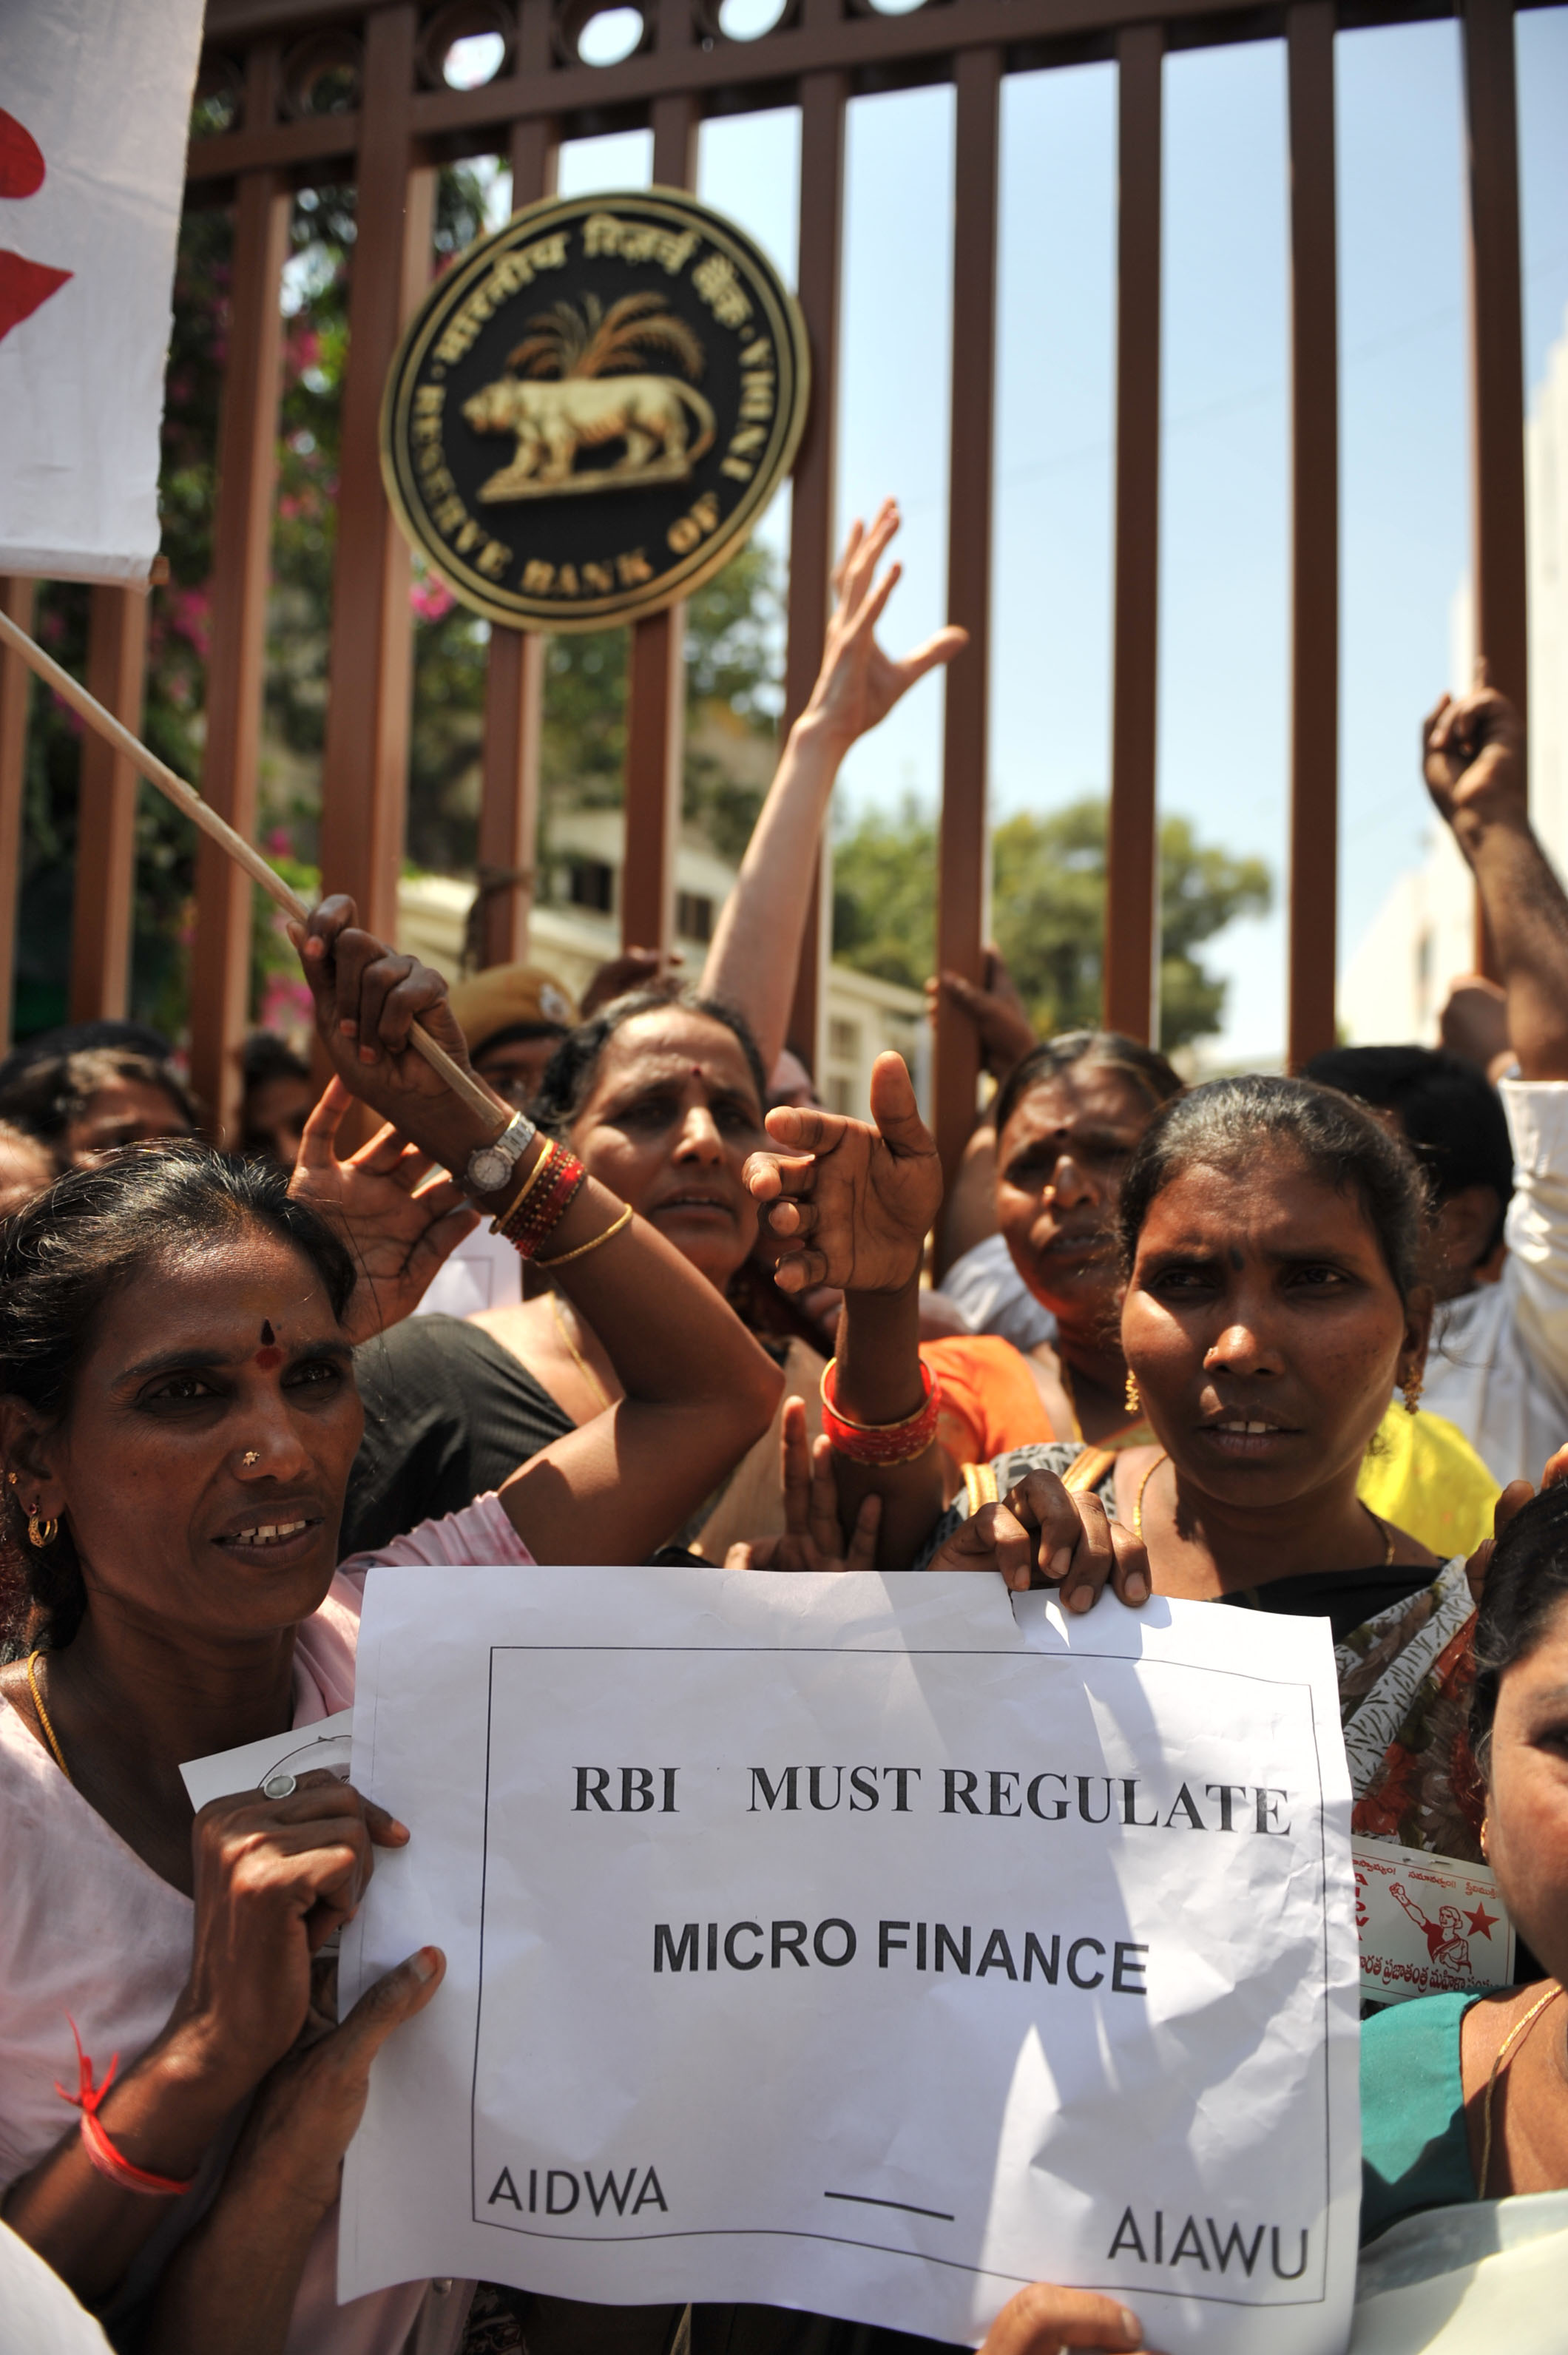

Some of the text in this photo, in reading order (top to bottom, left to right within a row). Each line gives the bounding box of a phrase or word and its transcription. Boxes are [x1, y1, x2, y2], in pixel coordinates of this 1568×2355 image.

[413, 339, 774, 592] RESERVE BANK OF INDIA
[570, 1766, 1292, 1837] RBI MUST REGULATE
[653, 1917, 1149, 1996] MICRO FINANCE
[487, 2164, 669, 2217] AIDWA
[1106, 2205, 1309, 2282] AIAWU
